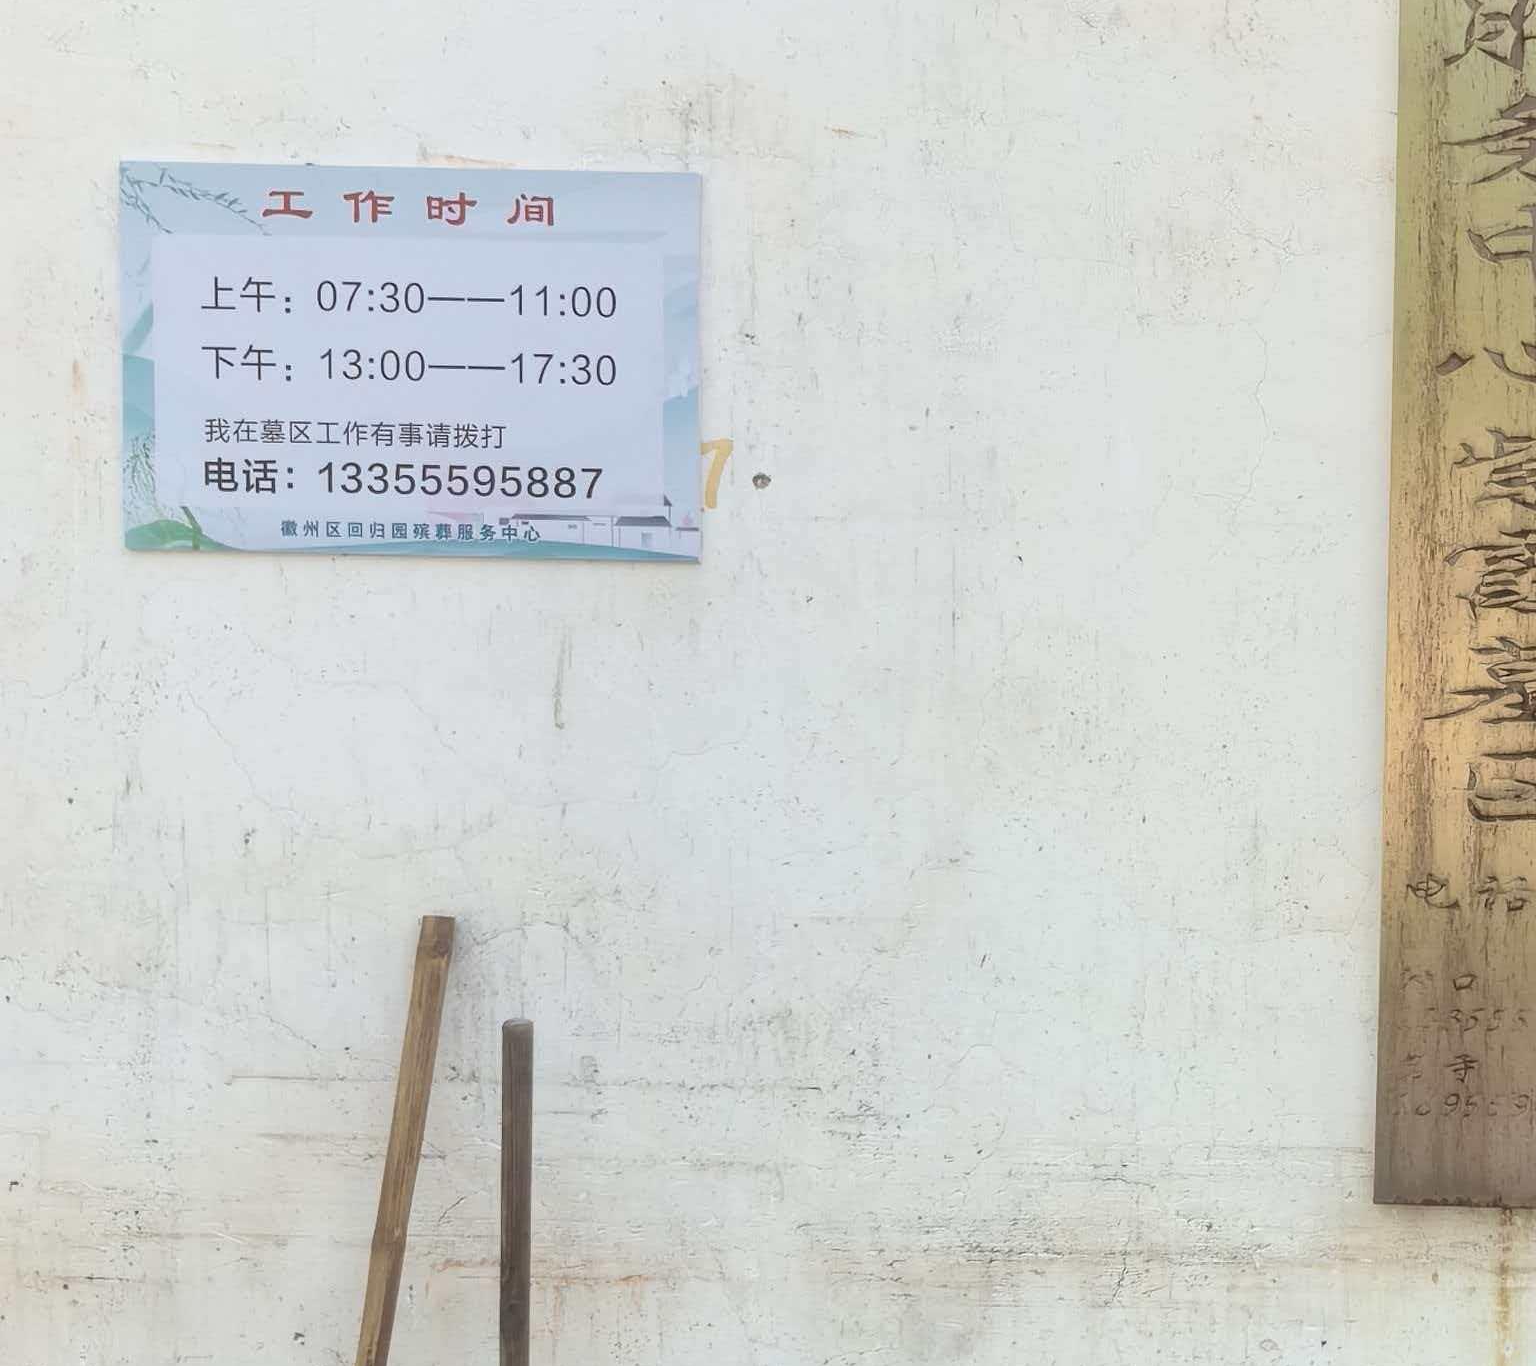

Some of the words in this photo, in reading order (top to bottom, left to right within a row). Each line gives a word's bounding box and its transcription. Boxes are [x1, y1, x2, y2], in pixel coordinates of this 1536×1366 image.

[261, 189, 555, 227] 工作时间
[204, 417, 507, 450] 我在墓区工作有事请拨打
[281, 519, 541, 543] 徽州区回归园殡葬服务中心
[1406, 873, 1536, 913] 电话
